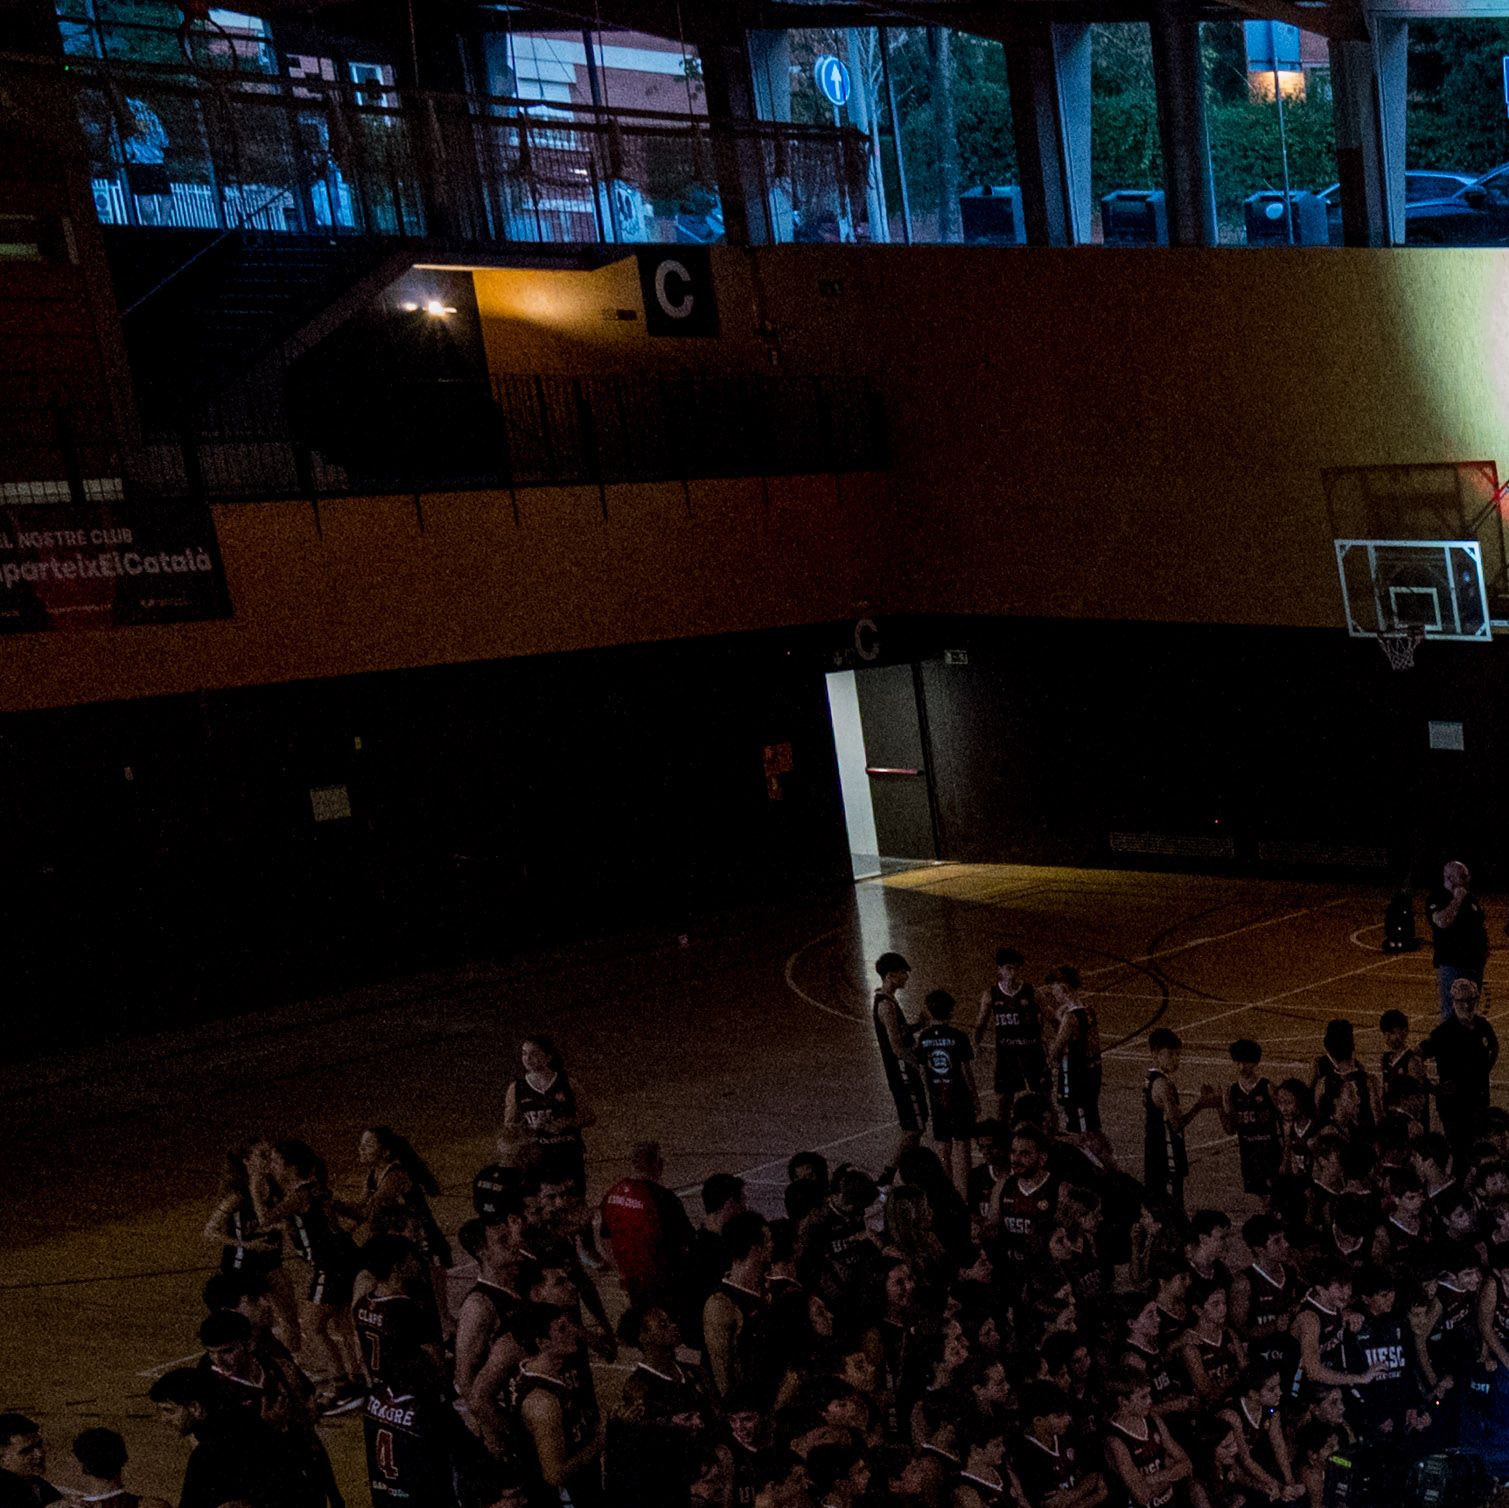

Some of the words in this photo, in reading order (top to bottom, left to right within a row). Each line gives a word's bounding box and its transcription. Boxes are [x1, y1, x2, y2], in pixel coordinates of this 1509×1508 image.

[655, 260, 696, 319] C
[0, 531, 15, 550] L
[18, 531, 88, 549] NOSTRE
[90, 528, 133, 545] CLUB
[854, 619, 880, 661] C
[1366, 1347, 1405, 1368] UESC
